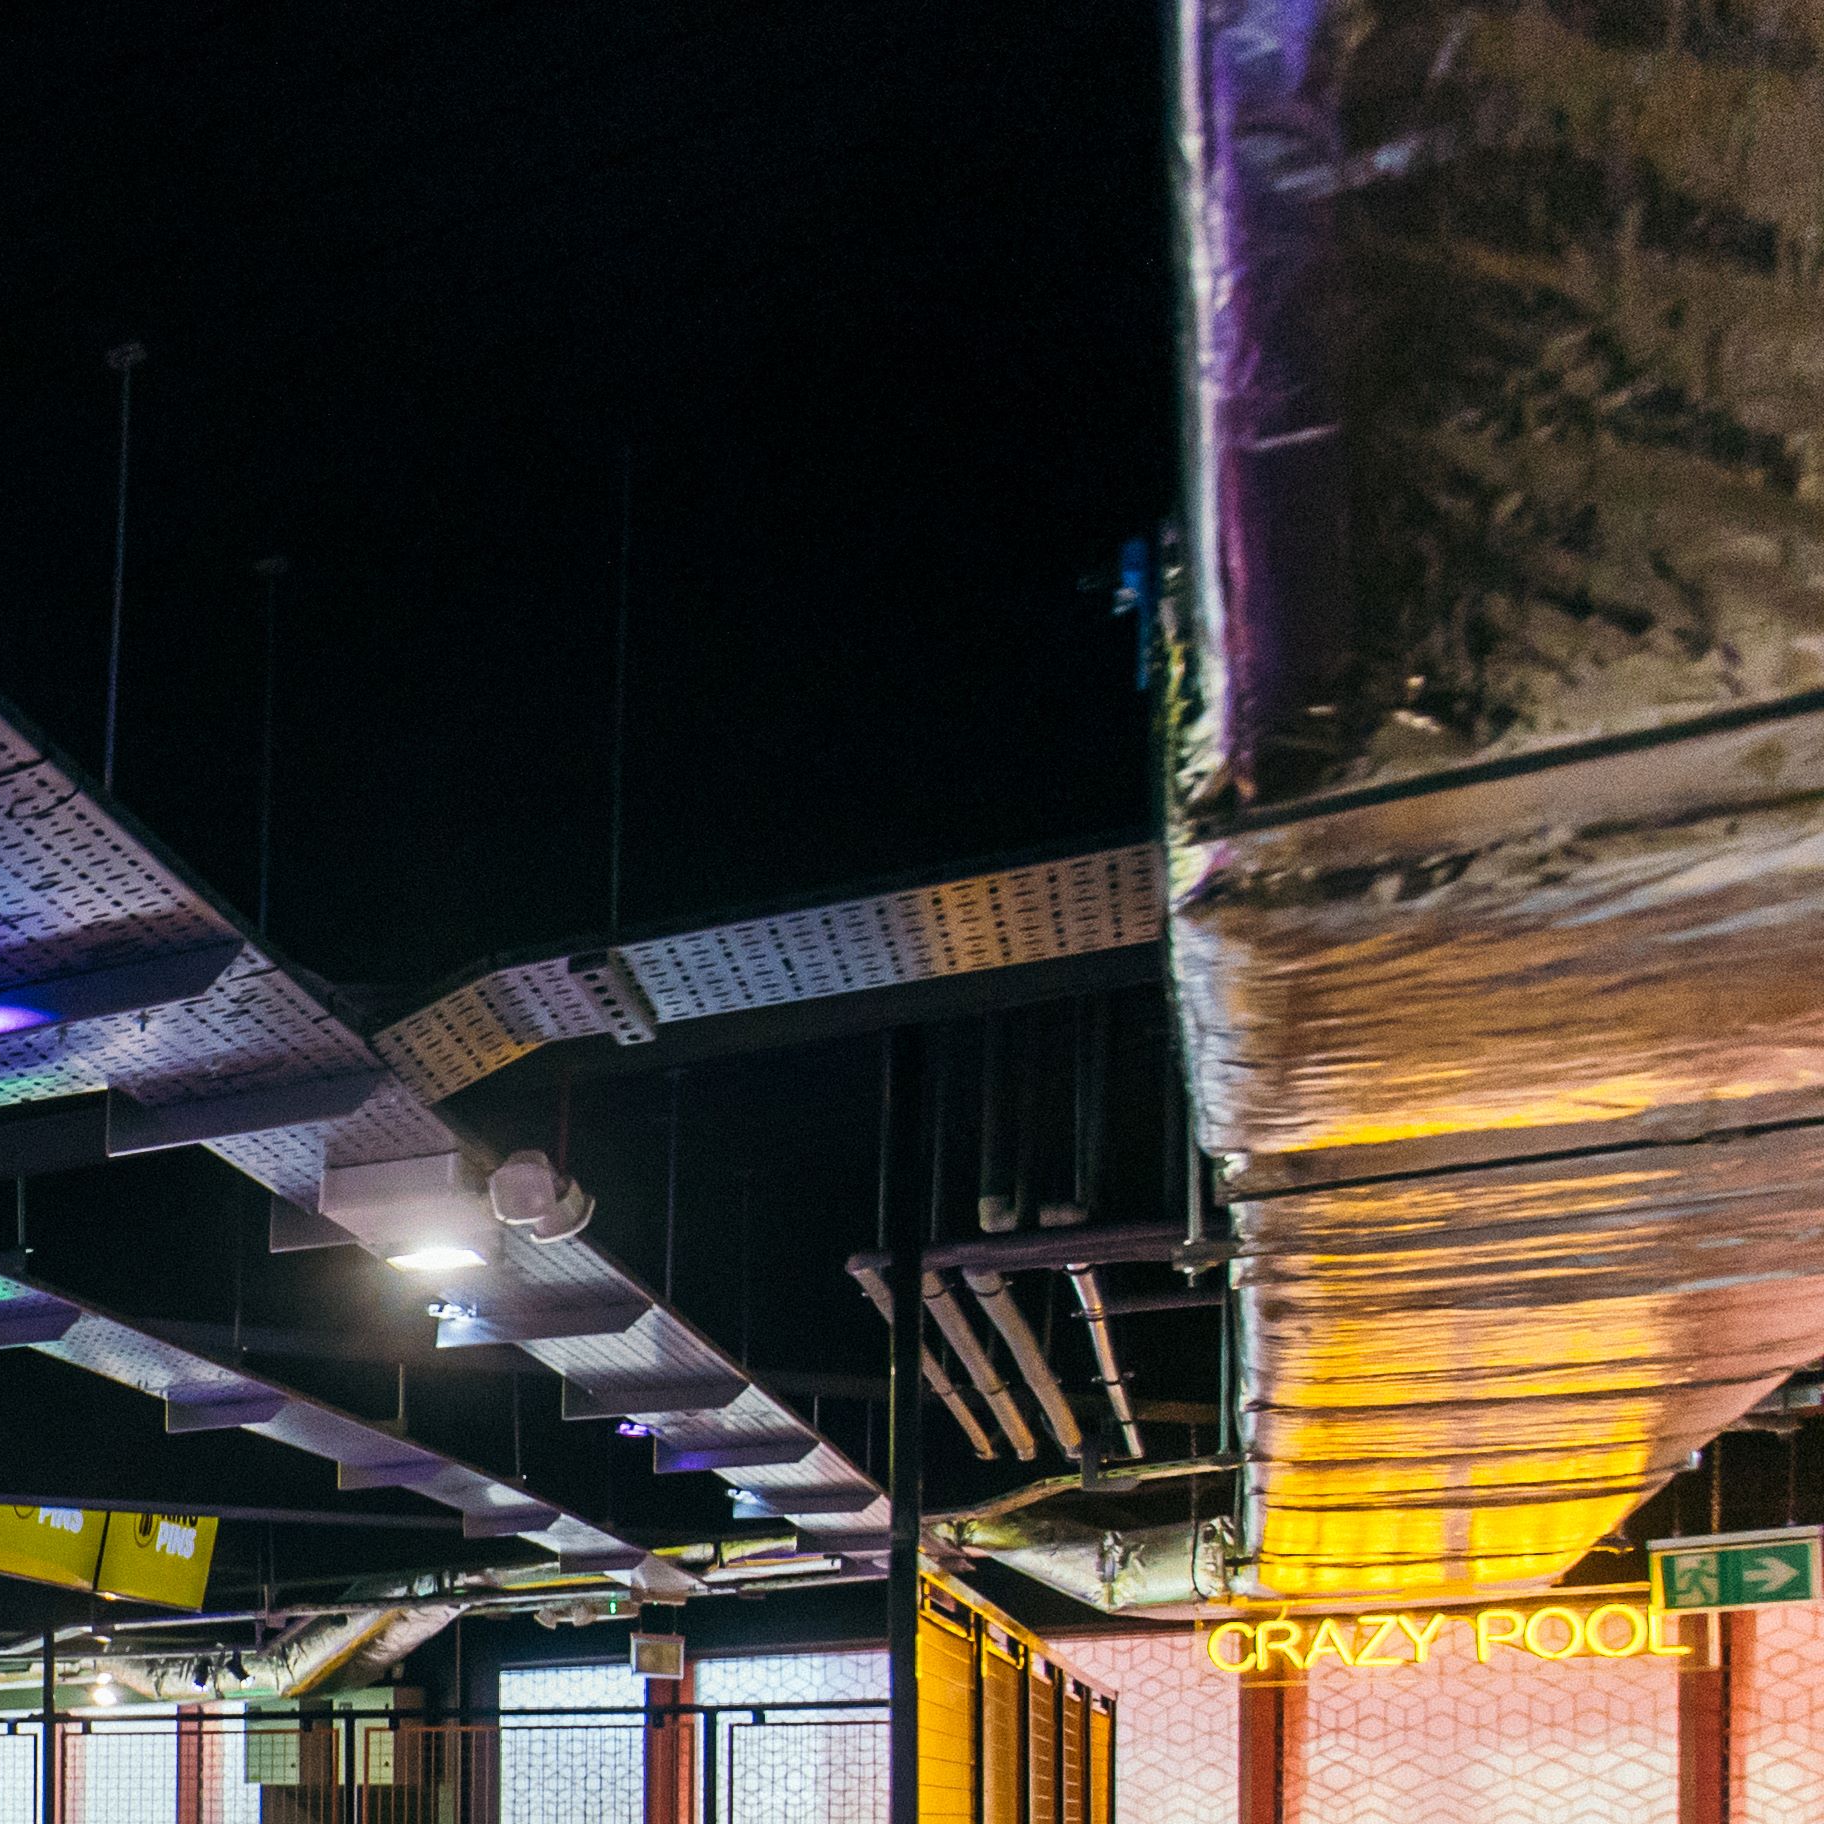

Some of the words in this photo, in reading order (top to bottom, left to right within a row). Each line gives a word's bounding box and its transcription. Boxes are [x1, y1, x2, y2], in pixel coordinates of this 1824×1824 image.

[156, 1520, 197, 1560] PINS
[1207, 1613, 1446, 1672] CRAZY
[1476, 1603, 1693, 1664] POOL
